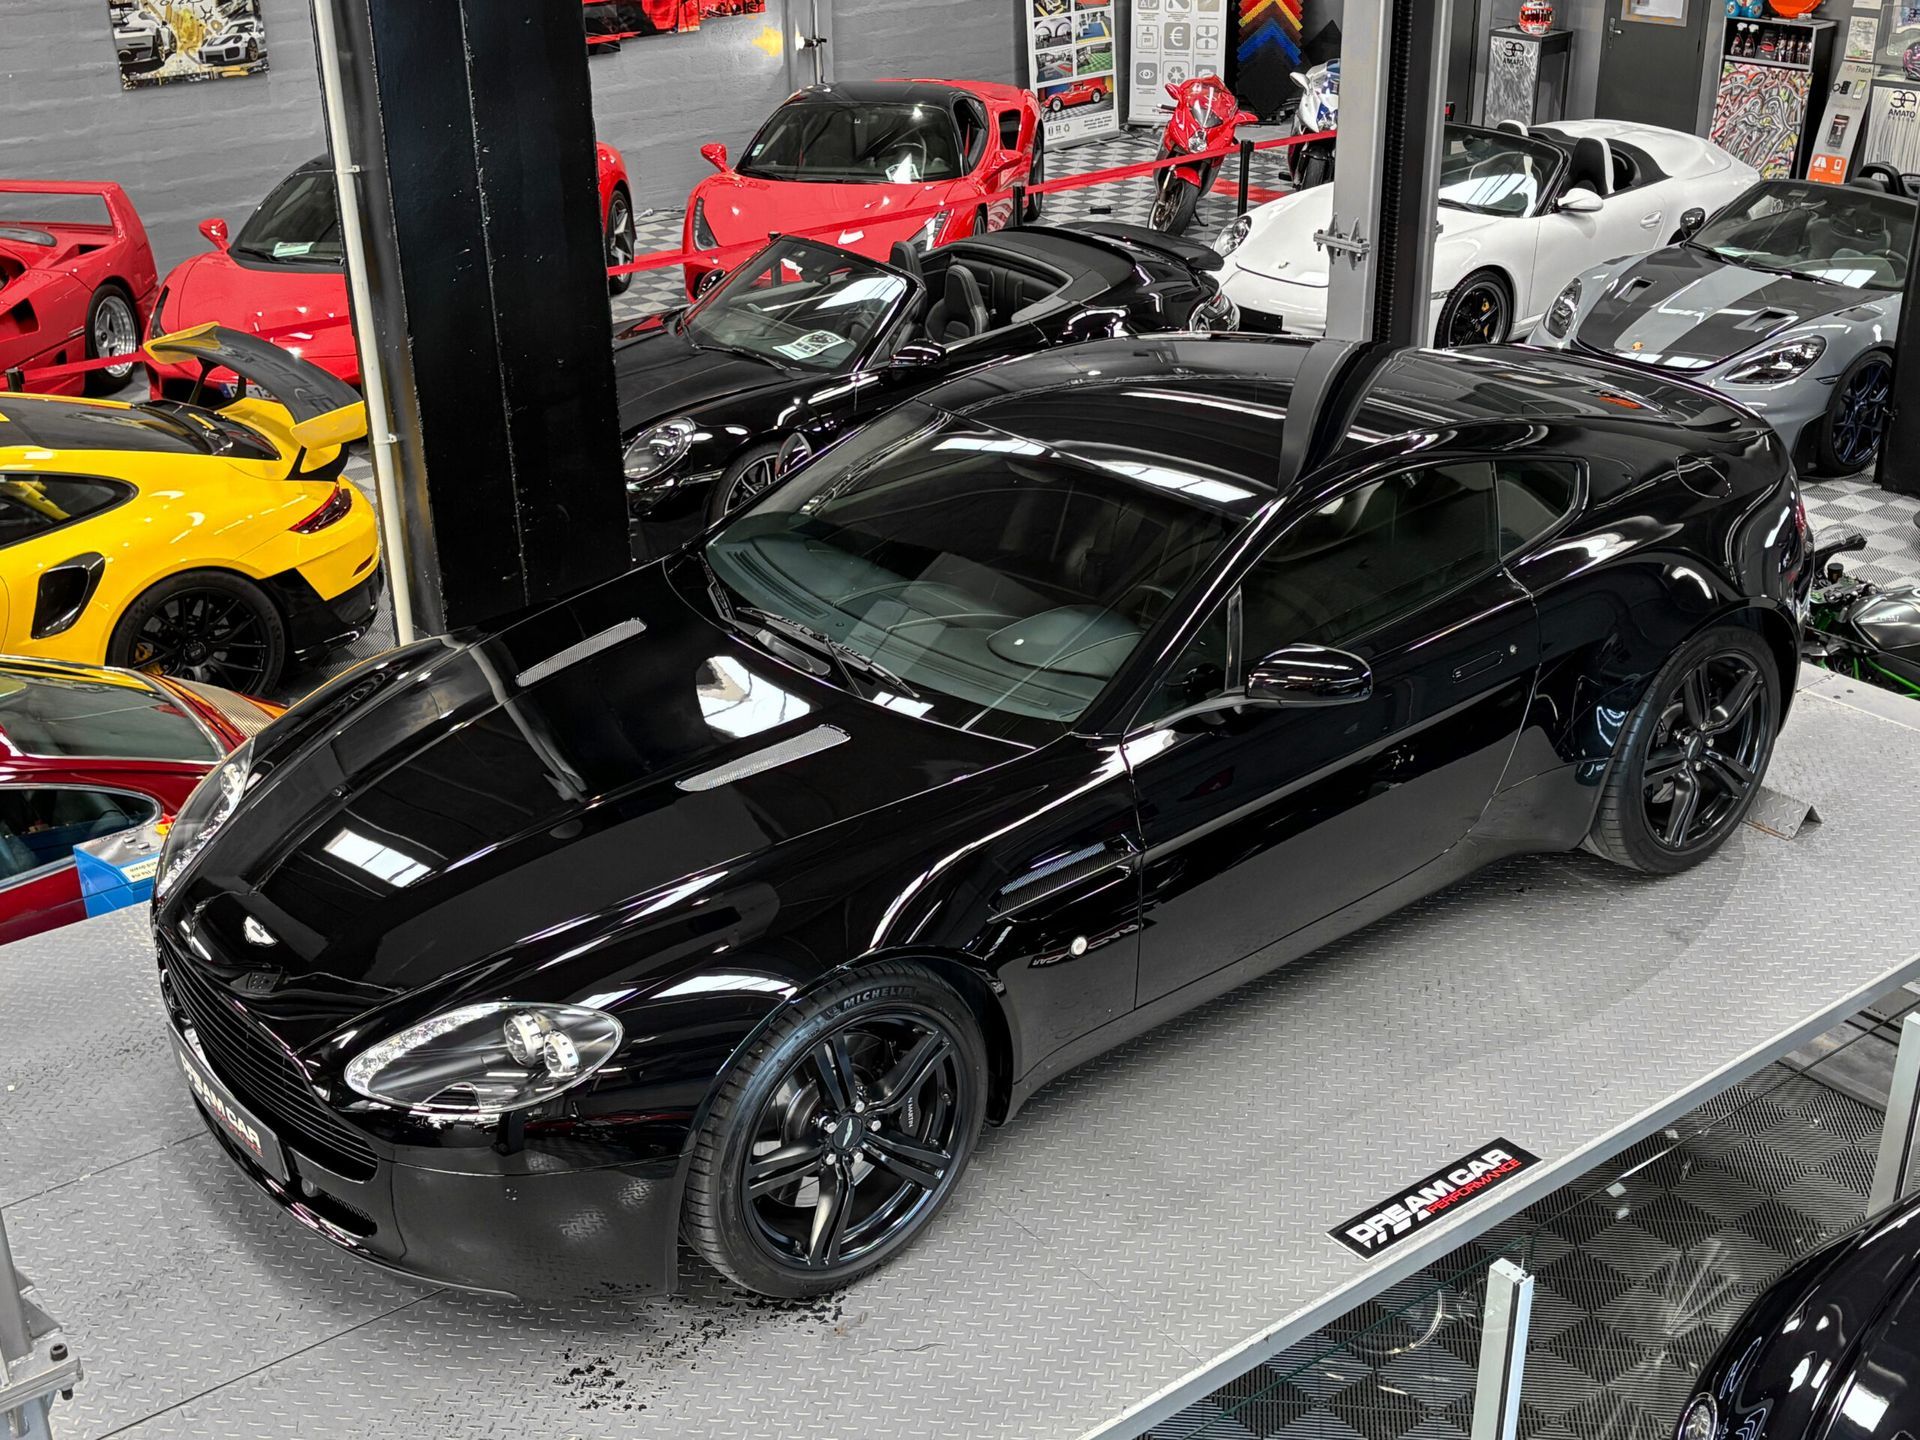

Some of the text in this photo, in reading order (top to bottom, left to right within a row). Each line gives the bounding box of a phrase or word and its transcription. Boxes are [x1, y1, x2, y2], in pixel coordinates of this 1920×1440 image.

[1888, 108, 1916, 118] AMATO
[843, 985, 914, 1010] MICHELIN
[225, 1106, 261, 1149] CAR
[1345, 1149, 1513, 1248] DREAM CAR
[1427, 1158, 1522, 1214] PERFORMANCE
